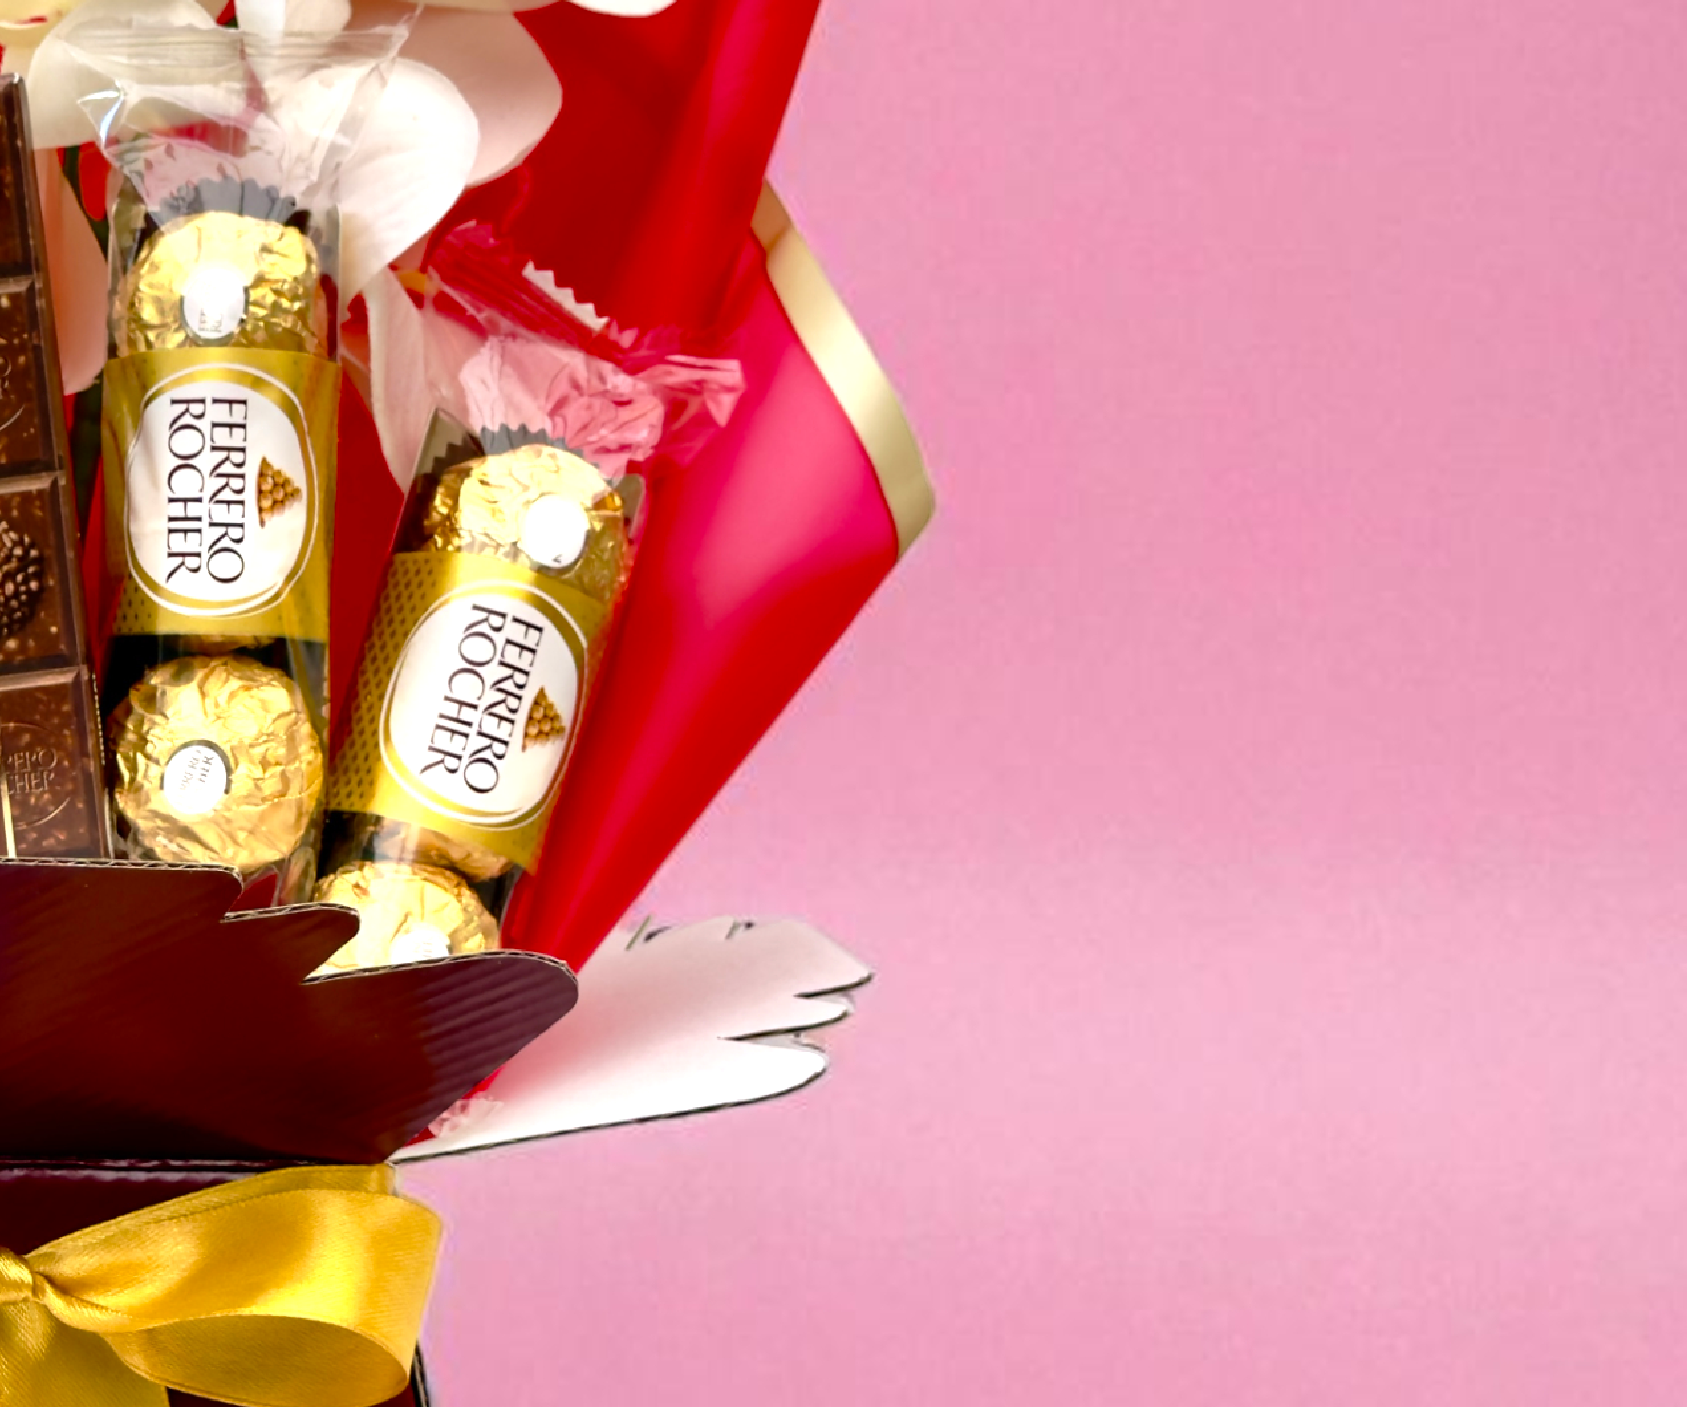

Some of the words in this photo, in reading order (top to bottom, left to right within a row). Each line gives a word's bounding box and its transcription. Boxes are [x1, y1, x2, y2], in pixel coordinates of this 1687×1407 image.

[167, 398, 206, 583] ROCHER
[208, 398, 248, 584] FERRERO
[421, 604, 508, 775] ROCHER
[464, 615, 544, 794] FERRERO
